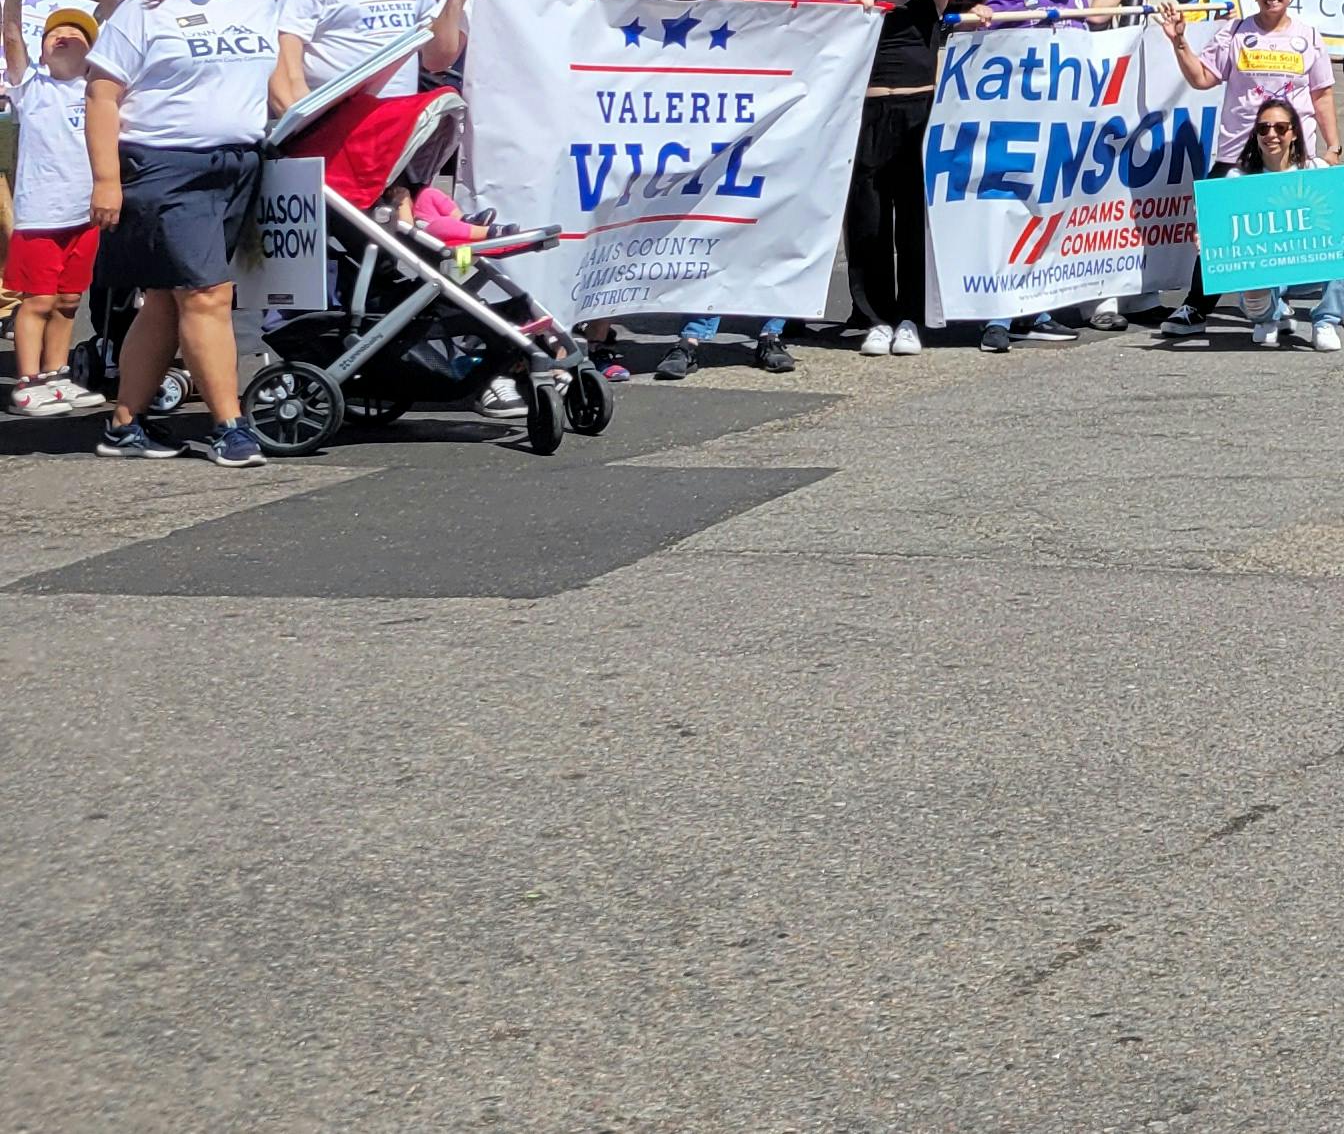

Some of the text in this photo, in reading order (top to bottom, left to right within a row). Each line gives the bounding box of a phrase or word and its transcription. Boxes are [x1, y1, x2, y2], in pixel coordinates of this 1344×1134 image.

[368, 3, 413, 13] VALERIE
[187, 36, 276, 57] BACA
[936, 41, 1110, 107] Kathy
[596, 91, 755, 123] VALERIE
[926, 106, 1218, 206] HENSON
[570, 137, 766, 212] VIGIL
[257, 194, 317, 225] JASON
[1065, 195, 1193, 228] ADAMS COUNT
[1231, 208, 1312, 242] JULIE
[262, 229, 318, 258] CROW
[627, 238, 720, 258] COUNTY
[1060, 223, 1196, 257] COMMISSIONER
[1206, 242, 1268, 261] DURAN
[963, 254, 1148, 294] WWW.KATHYFORADAMS.COM
[1208, 262, 1257, 274] COUNTY
[581, 287, 650, 311] DISTRICT 1
